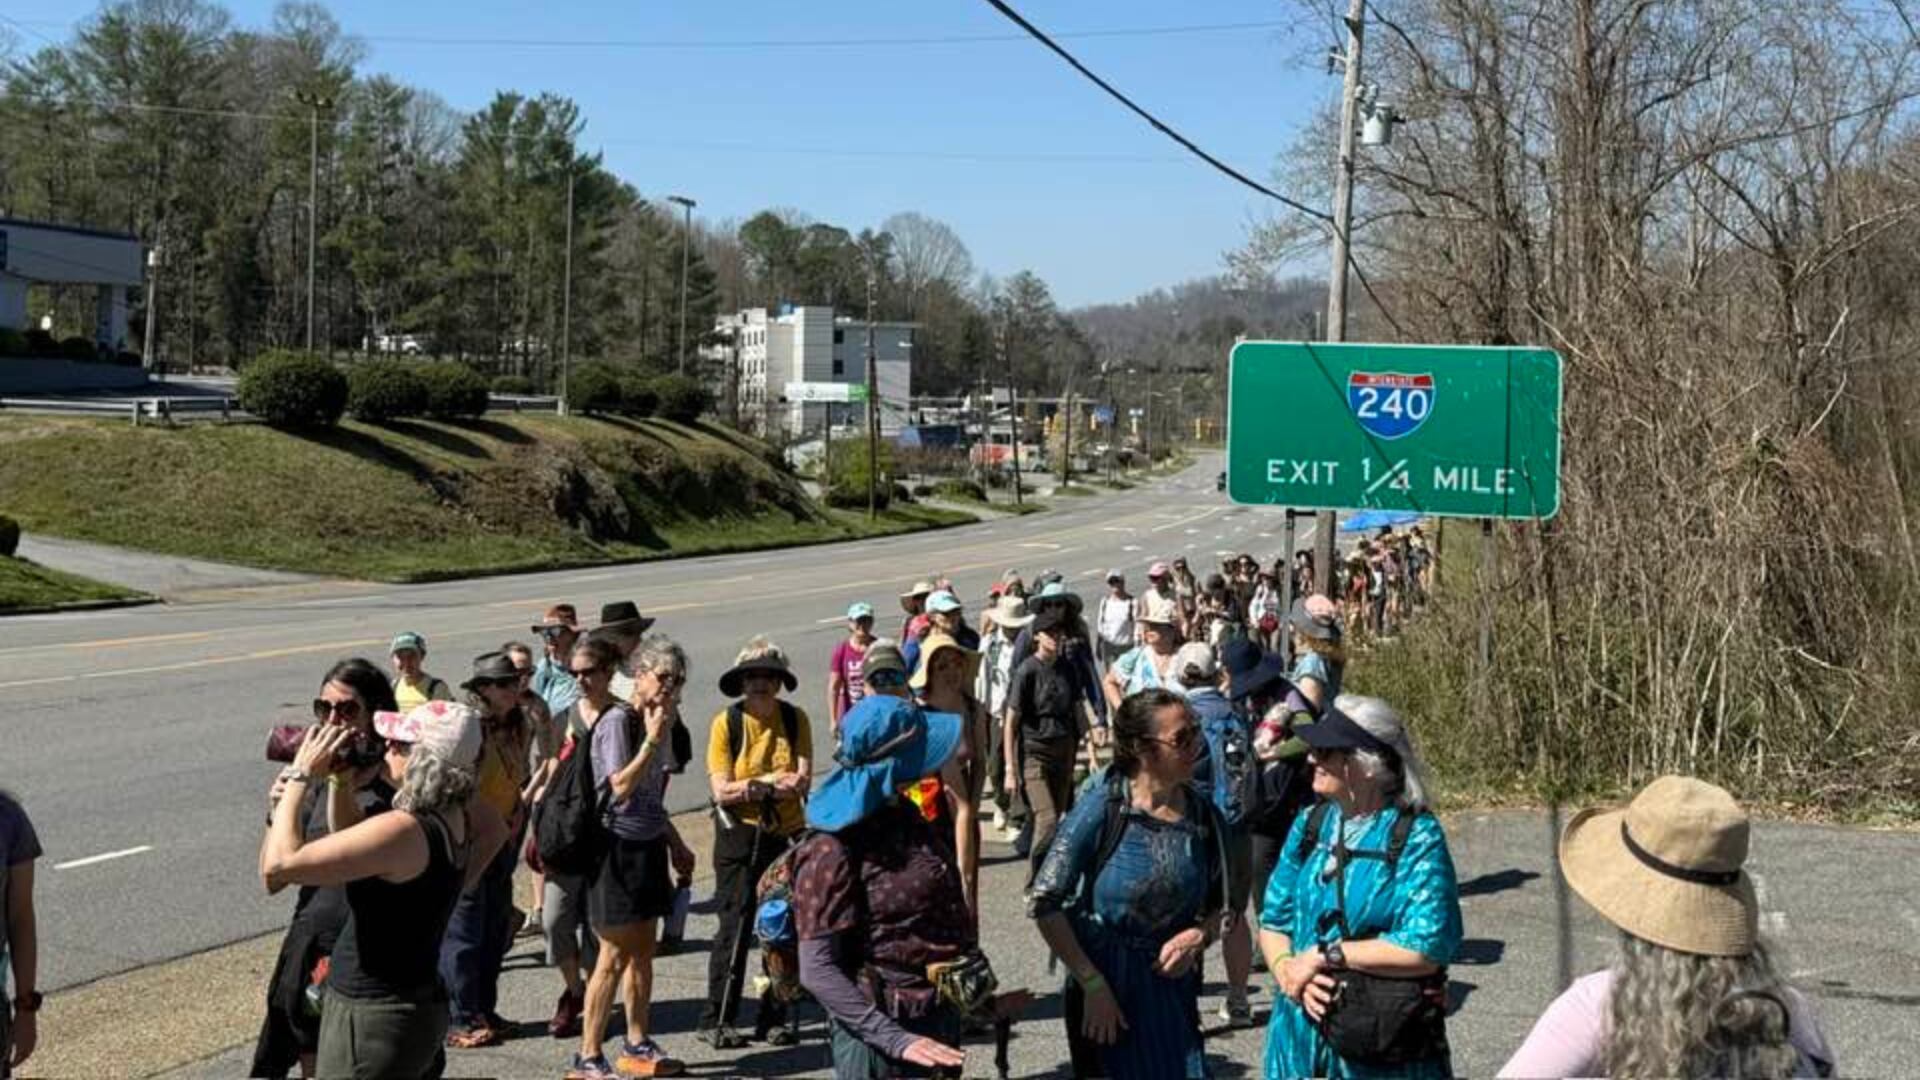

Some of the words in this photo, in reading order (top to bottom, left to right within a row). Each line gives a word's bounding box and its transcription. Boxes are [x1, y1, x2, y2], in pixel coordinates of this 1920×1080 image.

[1358, 387, 1428, 420] 240
[1267, 459, 1340, 485] EXIT
[1433, 465, 1515, 494] MILE
